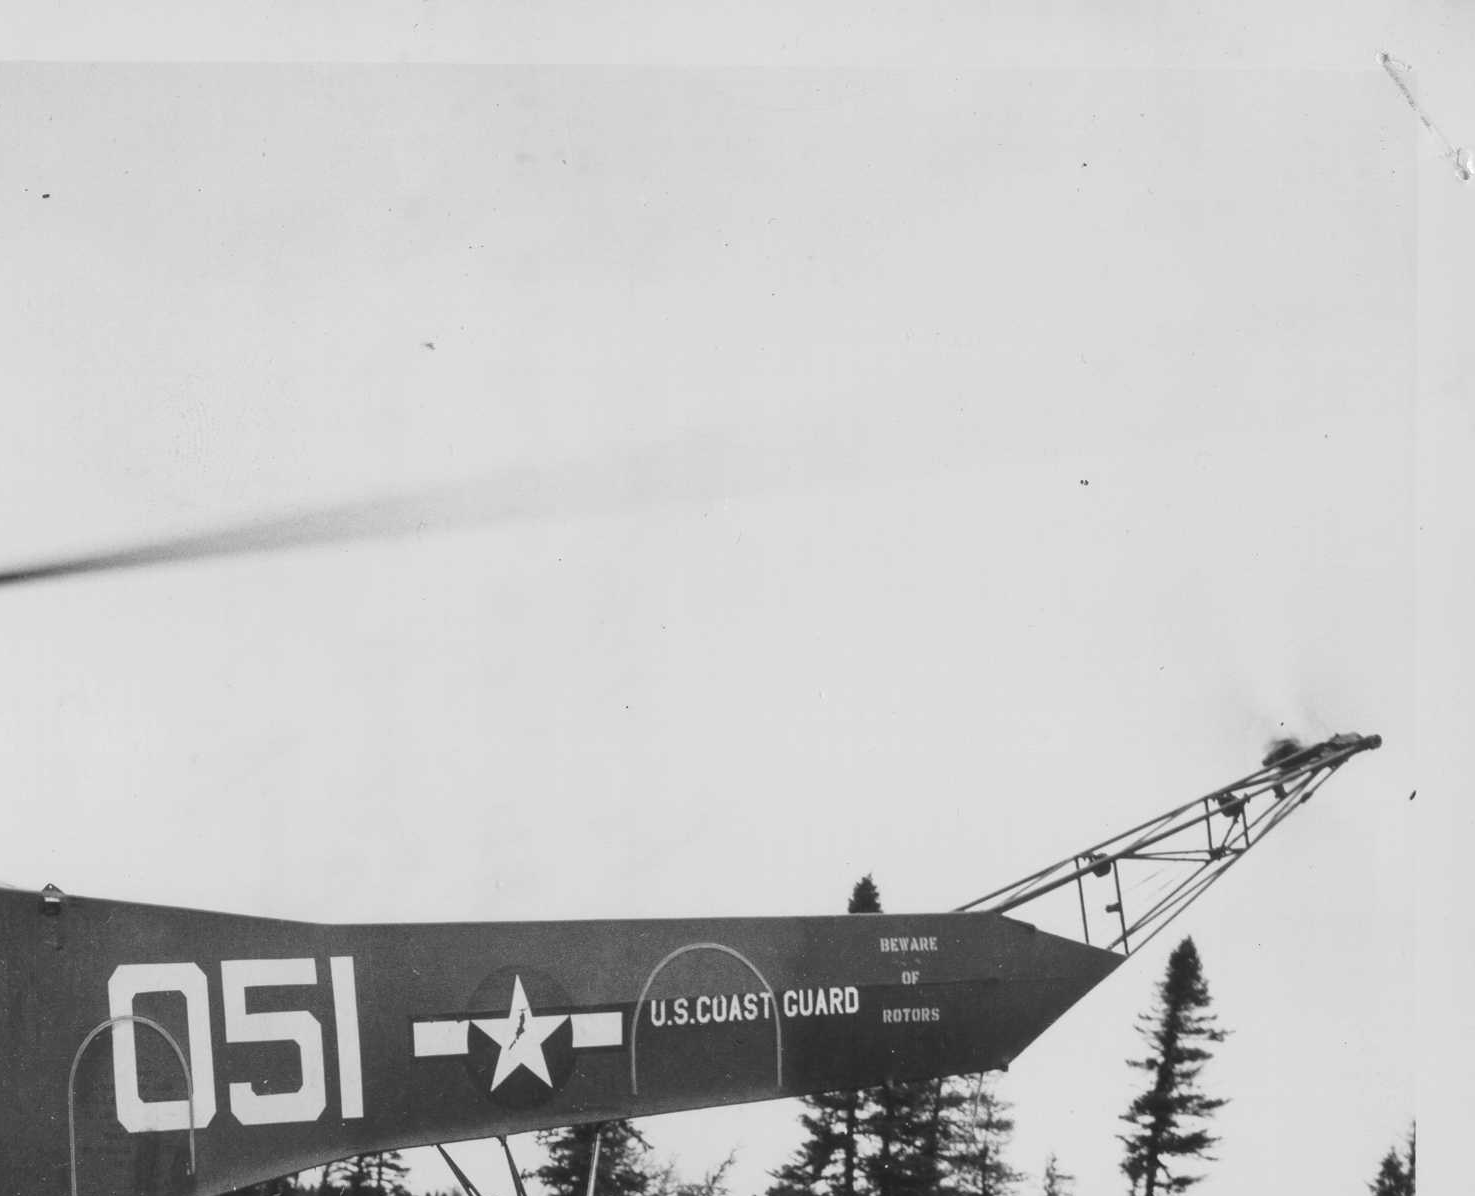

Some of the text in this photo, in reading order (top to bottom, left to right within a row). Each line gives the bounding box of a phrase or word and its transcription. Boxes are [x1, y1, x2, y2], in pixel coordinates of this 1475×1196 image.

[880, 936, 938, 953] BEWARE
[901, 970, 920, 985] OF
[783, 986, 860, 1017] GUARD
[882, 1007, 940, 1024] ROTORS
[108, 956, 364, 1133] 051
